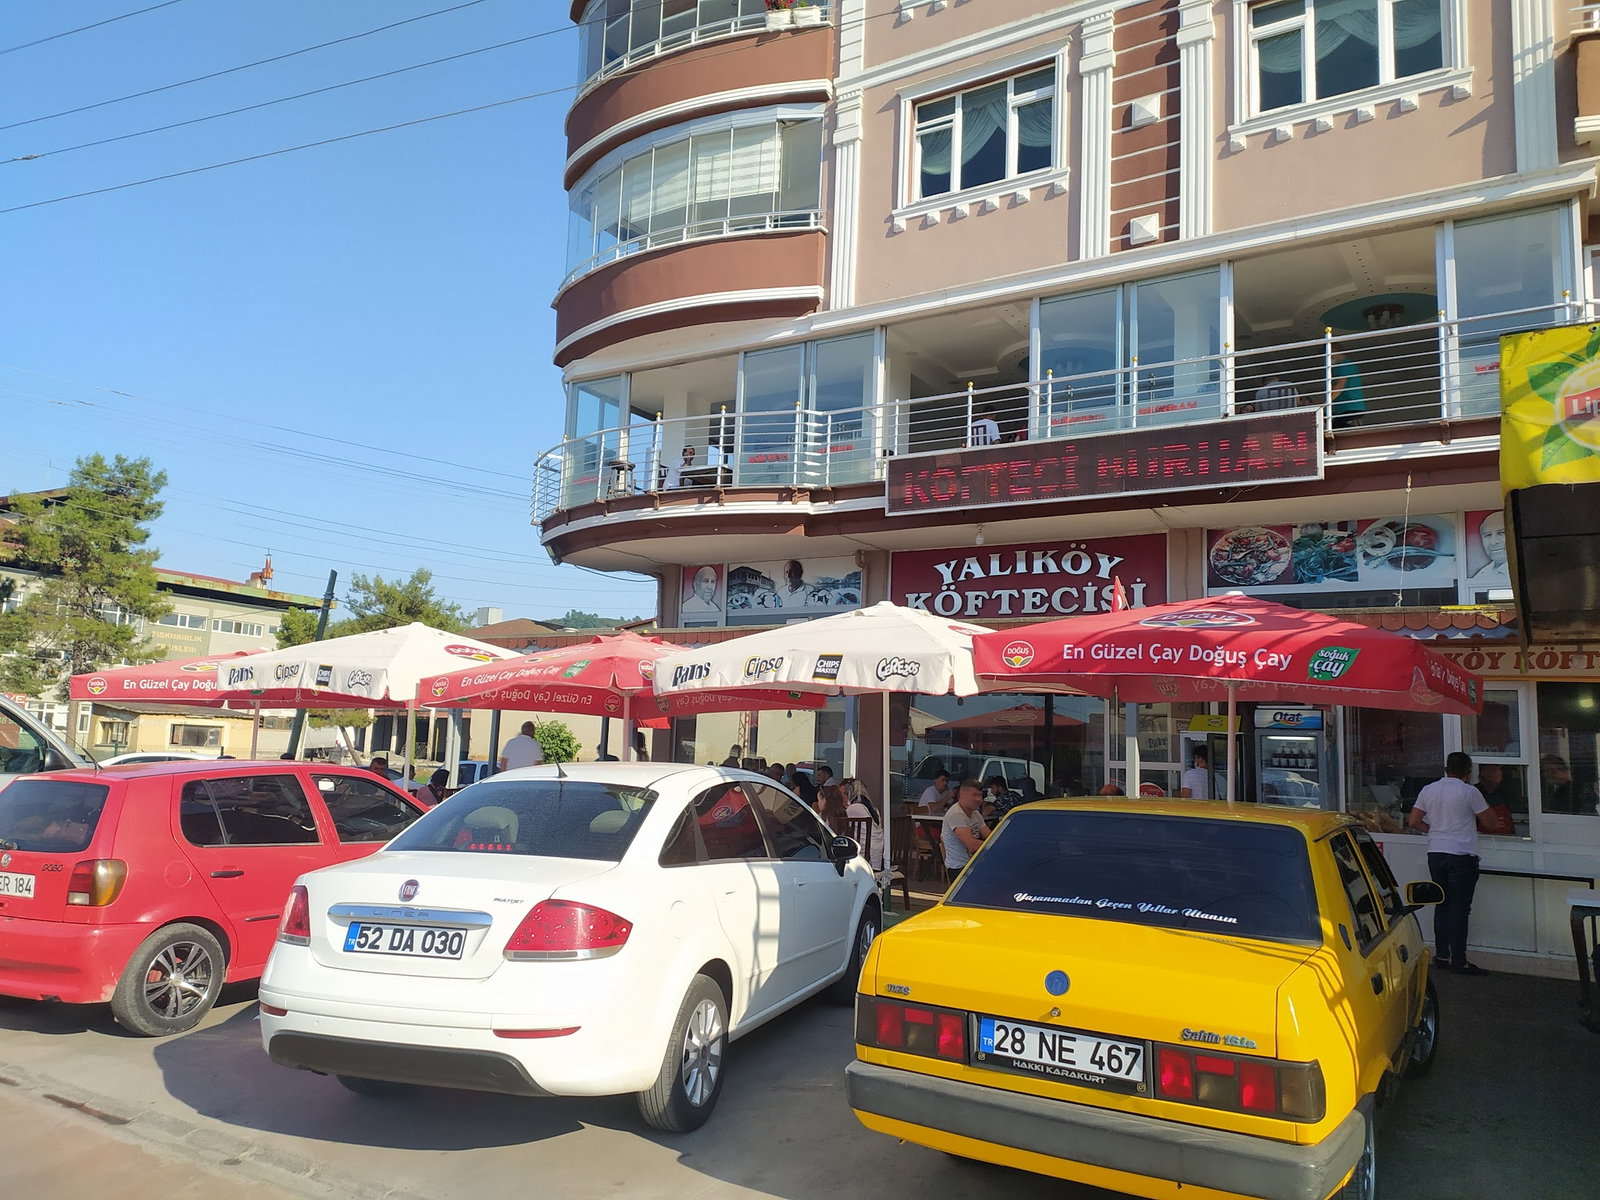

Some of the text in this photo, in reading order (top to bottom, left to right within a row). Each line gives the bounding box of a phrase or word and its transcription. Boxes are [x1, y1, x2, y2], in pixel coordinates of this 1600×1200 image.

[933, 543, 1124, 585] YALIKÖY
[905, 577, 1147, 616] KÖFTECİSİ
[1008, 647, 1029, 655] DOĞUŞ
[1063, 643, 1293, 671] En Güzel Çay Doğuş Çay
[1318, 649, 1349, 661] soğuk
[745, 656, 784, 679] Cipso
[815, 667, 838, 675] MASTER
[817, 659, 840, 668] CHIPS
[1313, 660, 1345, 678] çay
[124, 679, 217, 691] En Güzel Çay Doğu
[461, 677, 471, 687] En
[474, 672, 500, 685] Güzel
[499, 671, 516, 681] Çay
[516, 667, 542, 678] Doğuş
[543, 665, 561, 675] Çay
[1273, 711, 1302, 722] Otat
[15, 877, 32, 895] 184
[1014, 892, 1092, 905] Yaşanmadan
[1095, 898, 1133, 910] Geçen
[1137, 902, 1179, 915] Yıllar
[373, 909, 429, 919] LINEA
[357, 926, 383, 950] 52
[389, 928, 415, 952] DA
[421, 930, 463, 955] 030
[983, 1025, 1141, 1076] TR 28 NE 467
[1013, 1060, 1107, 1085] HAKKI KARAKURT
